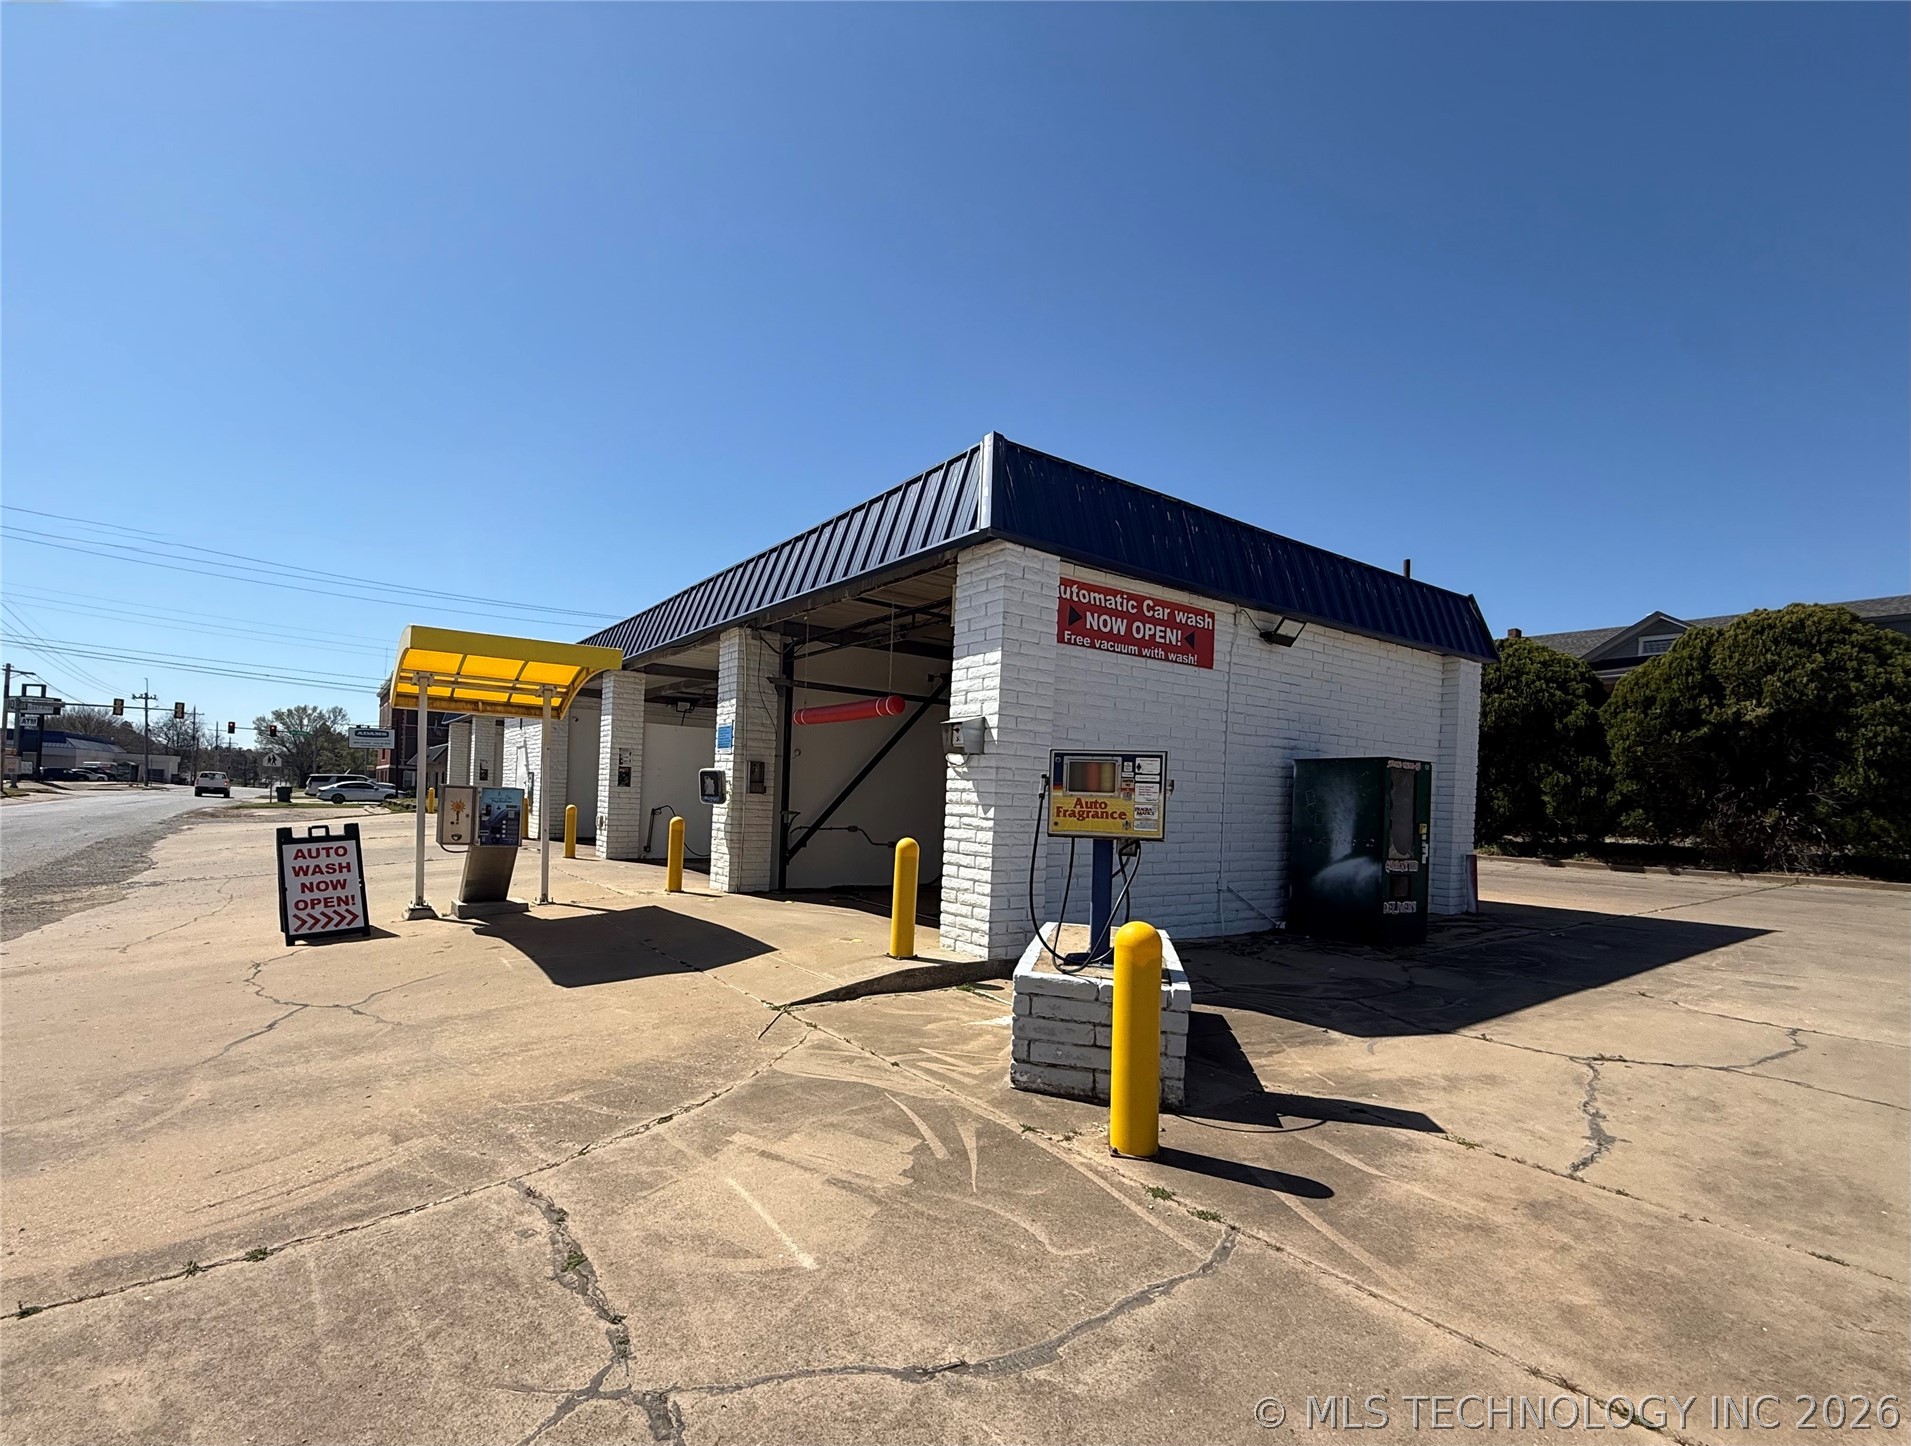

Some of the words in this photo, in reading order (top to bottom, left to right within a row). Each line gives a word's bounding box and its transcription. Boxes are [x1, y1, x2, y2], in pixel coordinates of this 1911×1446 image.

[1058, 584, 1137, 612] utomatic
[1143, 600, 1170, 620] Car
[1175, 610, 1213, 630] wash
[1086, 612, 1127, 636] NOW
[1132, 622, 1182, 647] OPEN!
[1064, 631, 1091, 647] Free
[1094, 639, 1139, 656] vacuum
[1141, 646, 1165, 660] with
[1168, 652, 1198, 665] wash!
[1073, 798, 1108, 810] Auto
[1056, 806, 1127, 821] Fragrance
[293, 846, 348, 860] AUTO
[291, 862, 351, 877] WASH
[300, 879, 347, 893] NOW
[293, 894, 356, 911] OPEN!
